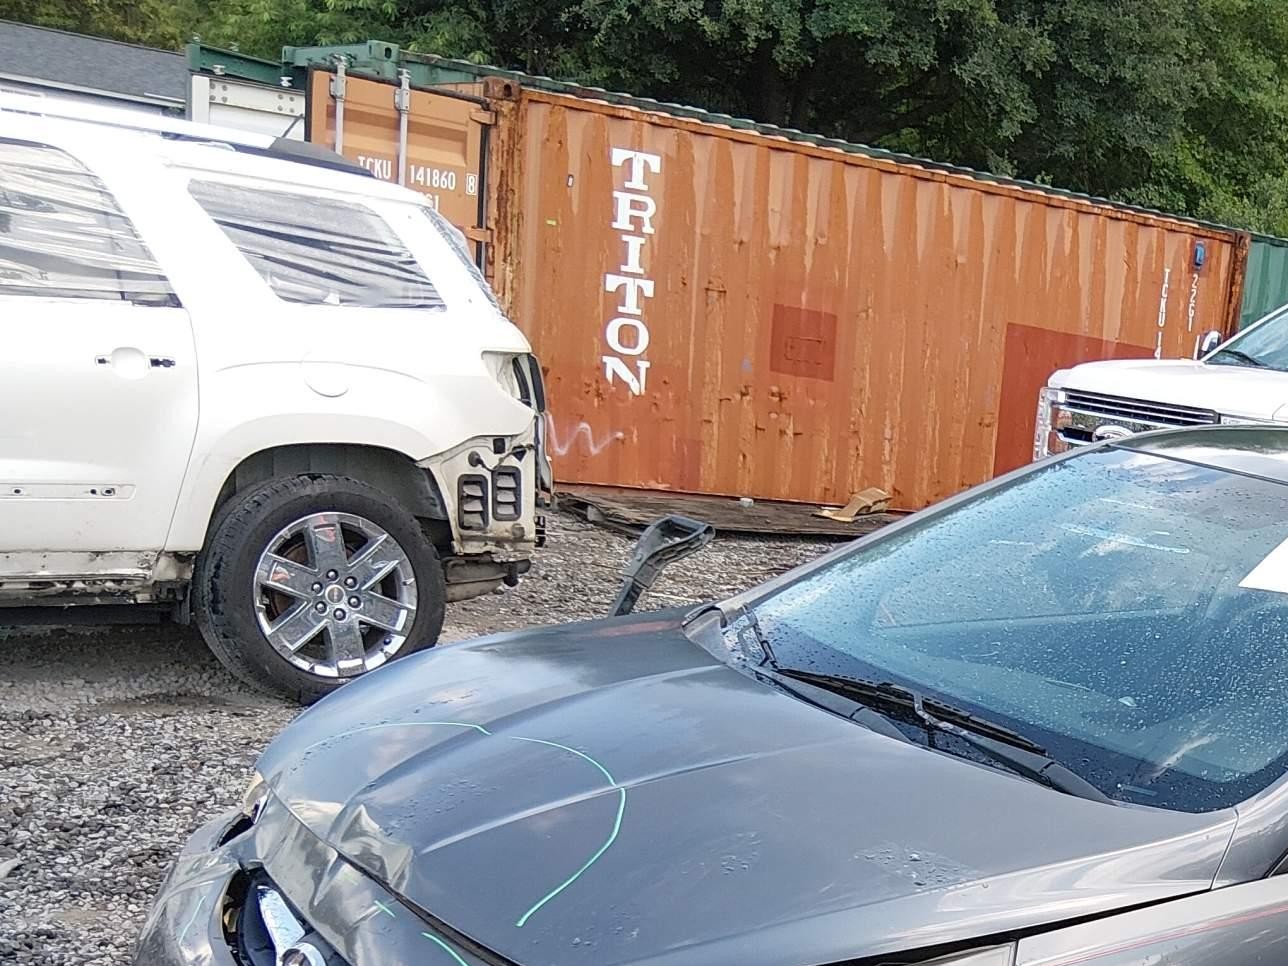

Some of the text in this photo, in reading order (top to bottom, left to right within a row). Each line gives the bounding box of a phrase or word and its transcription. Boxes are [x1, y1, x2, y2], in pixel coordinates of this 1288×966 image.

[357, 155, 392, 180] TCKU
[410, 164, 456, 191] 141860
[602, 148, 661, 396] TRITON
[1157, 267, 1171, 328] TCKU
